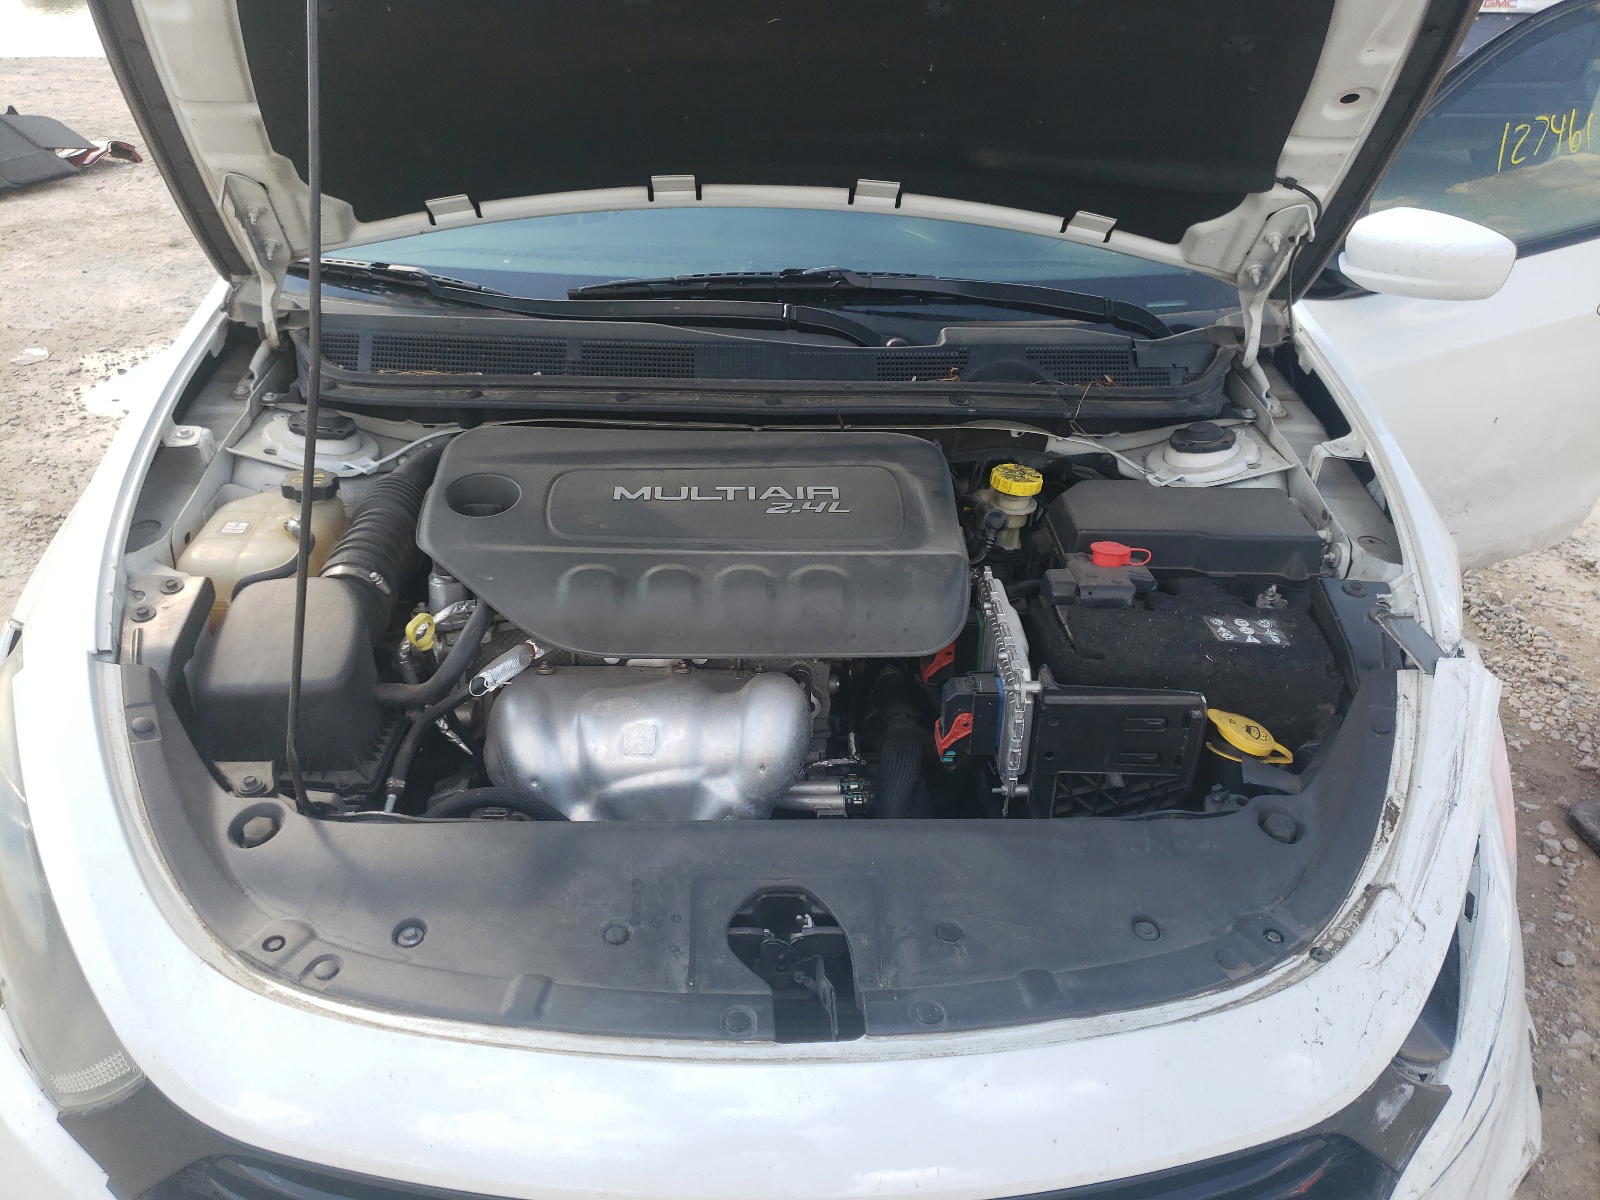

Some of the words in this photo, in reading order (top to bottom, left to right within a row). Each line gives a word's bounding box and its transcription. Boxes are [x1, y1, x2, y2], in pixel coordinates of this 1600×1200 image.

[1483, 0, 1517, 8] GMC
[1497, 108, 1594, 173] 127461
[613, 486, 840, 501] MULTIAIR
[765, 502, 850, 514] 2.4L
